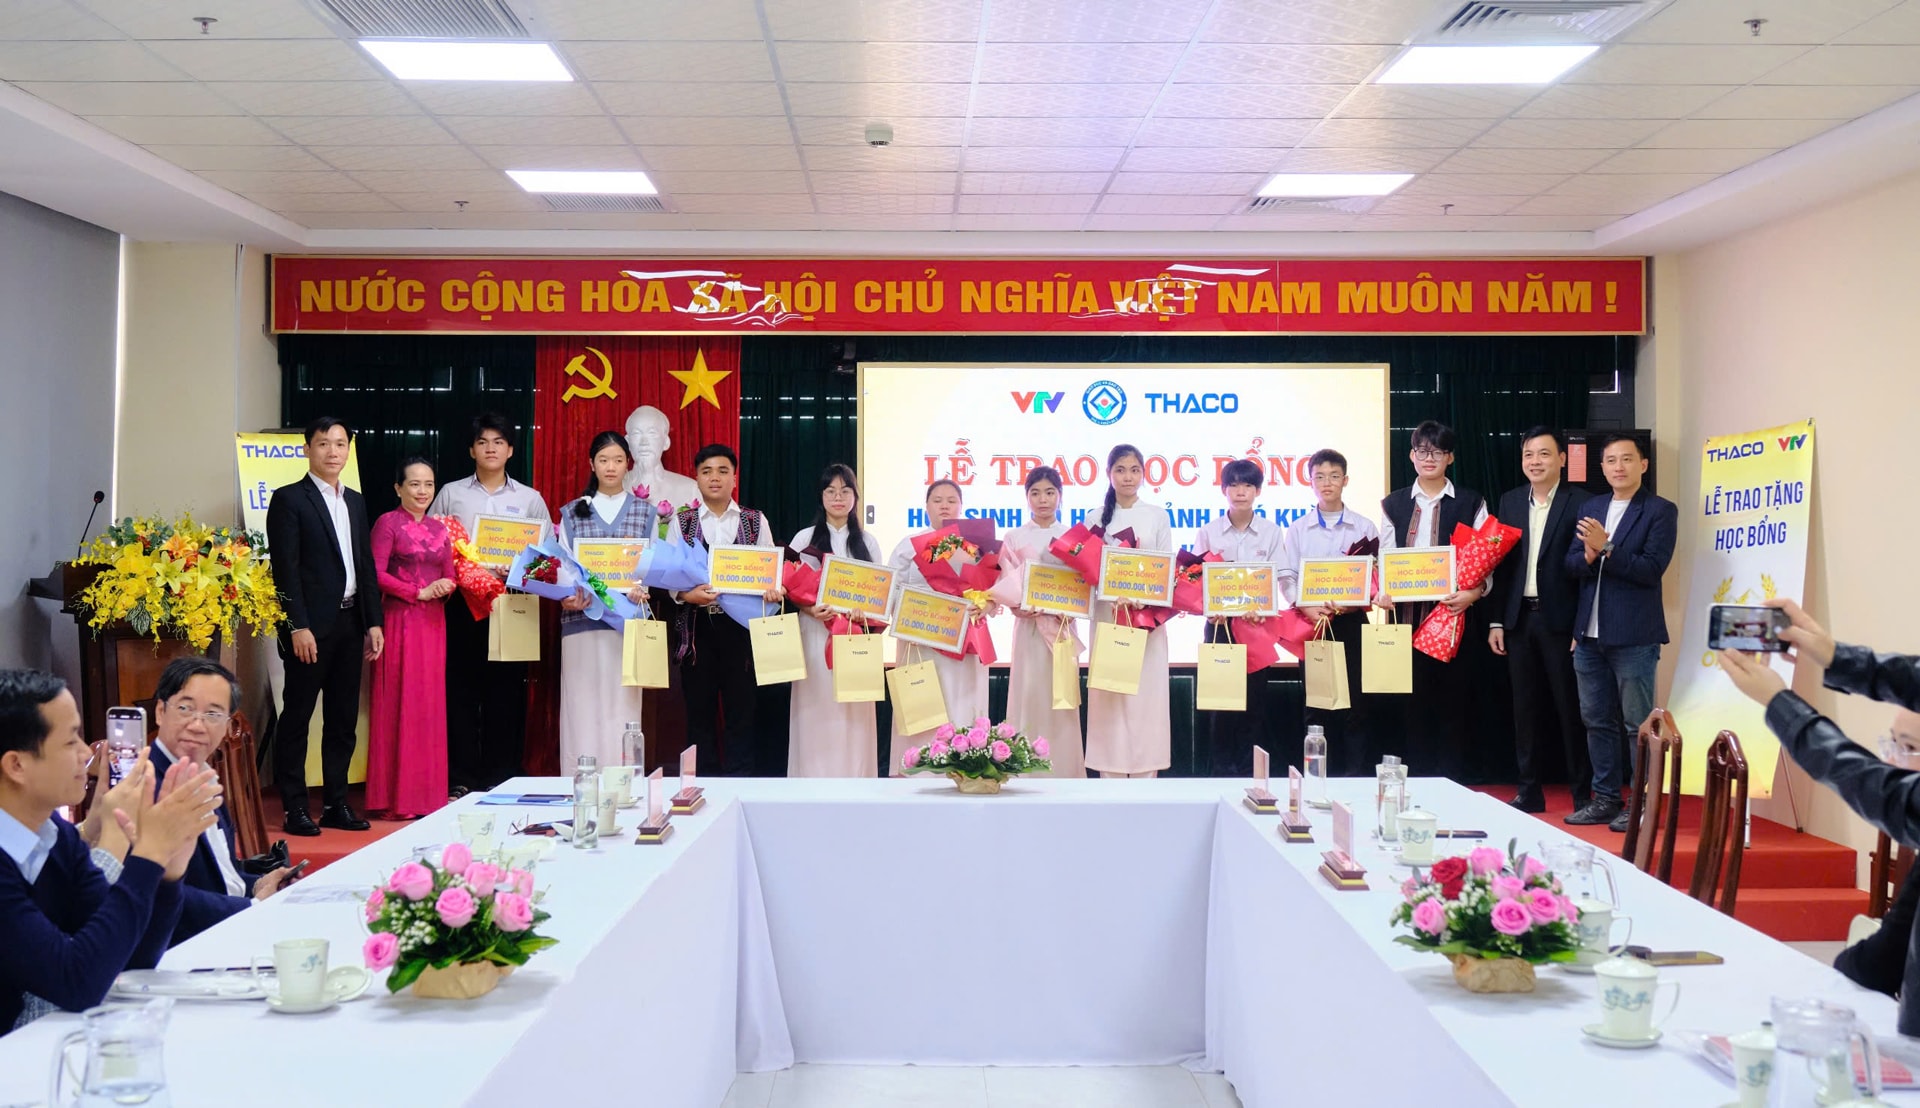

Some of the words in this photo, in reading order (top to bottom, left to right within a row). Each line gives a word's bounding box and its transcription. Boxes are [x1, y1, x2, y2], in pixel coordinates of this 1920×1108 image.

[300, 270, 425, 313] NƯỚC
[441, 271, 565, 321] CỘNG
[582, 269, 670, 312] HÒA
[688, 273, 748, 313] XÃ
[764, 272, 837, 322] HỘI
[853, 268, 944, 313] CHỦ
[962, 273, 1098, 313] NGHĨA
[1109, 273, 1202, 322] VIỆT
[1218, 281, 1321, 313] NAM
[1338, 271, 1473, 314] MUÔN
[1488, 271, 1591, 313] NĂM
[1605, 281, 1617, 313] !
[1011, 391, 1065, 413] VTV
[1145, 393, 1239, 414] THACO
[242, 445, 306, 458] THACO
[1707, 441, 1765, 462] THACO
[1777, 434, 1808, 452] VTV
[924, 438, 977, 486] LỄ
[990, 454, 1098, 487] TRAO
[1144, 454, 1200, 493] ỌC
[249, 481, 268, 510] LỄ
[1704, 485, 1722, 516] LỄ
[1725, 487, 1761, 513] TRAO
[1765, 480, 1804, 511] TẶNG
[965, 508, 1022, 528] SINH
[1165, 502, 1210, 528] ẢNH
[1715, 529, 1743, 554] HỌC
[1747, 514, 1787, 547] BỔNG
[715, 574, 754, 583] 10.000.000
[1107, 580, 1145, 591] 10.000.000
[1388, 580, 1428, 590] 10.000.000
[828, 588, 866, 603] 10.000.000
[1031, 591, 1068, 604] 10.000.000
[1306, 587, 1344, 596] 10.000.000
[901, 617, 939, 633] 10.000.000
